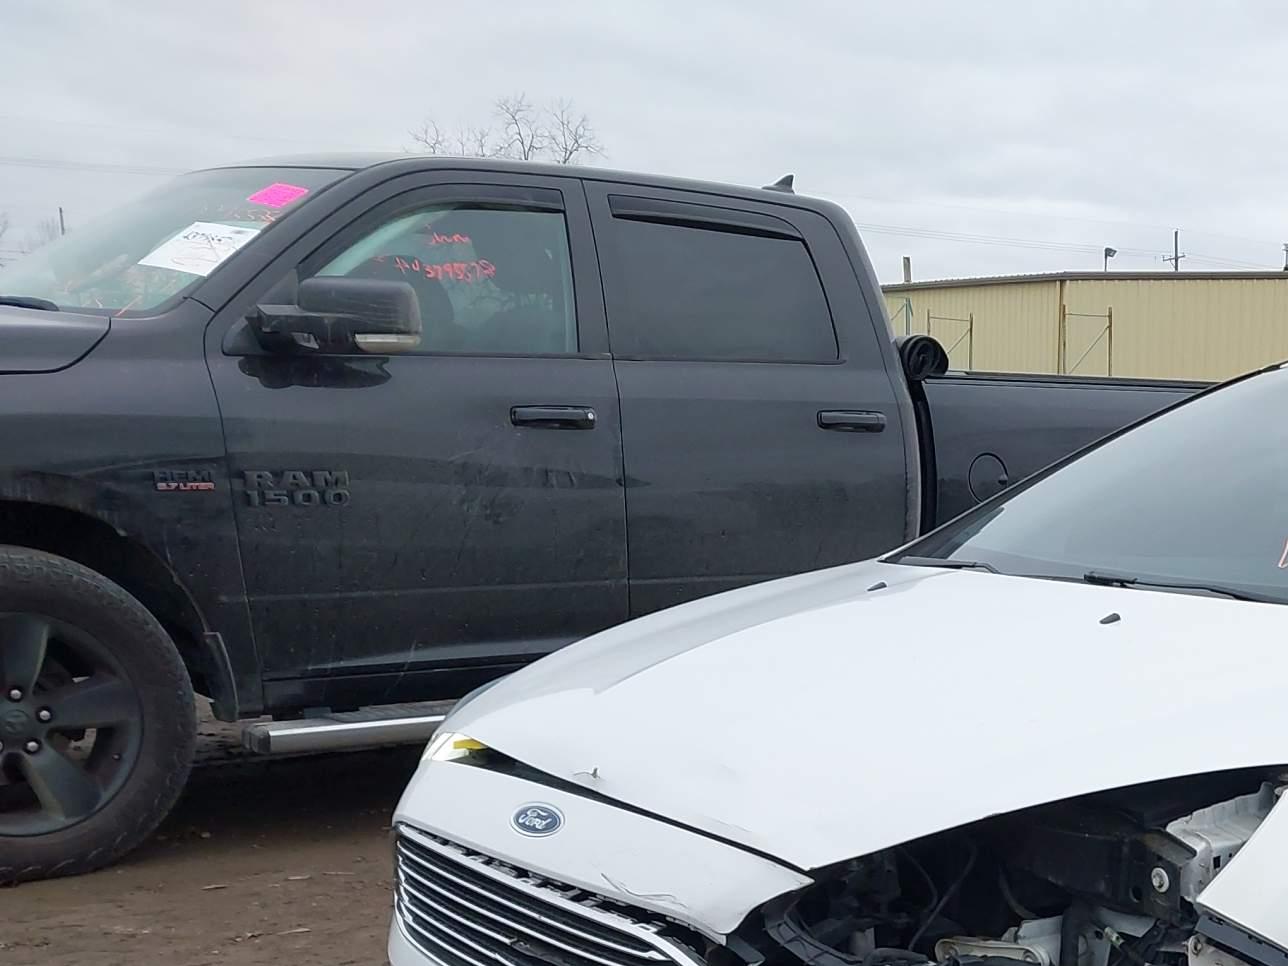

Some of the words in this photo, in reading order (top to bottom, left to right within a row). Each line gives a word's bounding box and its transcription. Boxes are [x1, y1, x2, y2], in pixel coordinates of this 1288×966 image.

[244, 470, 350, 488] RAM
[246, 489, 351, 507] 1500
[518, 808, 553, 830] Ford
